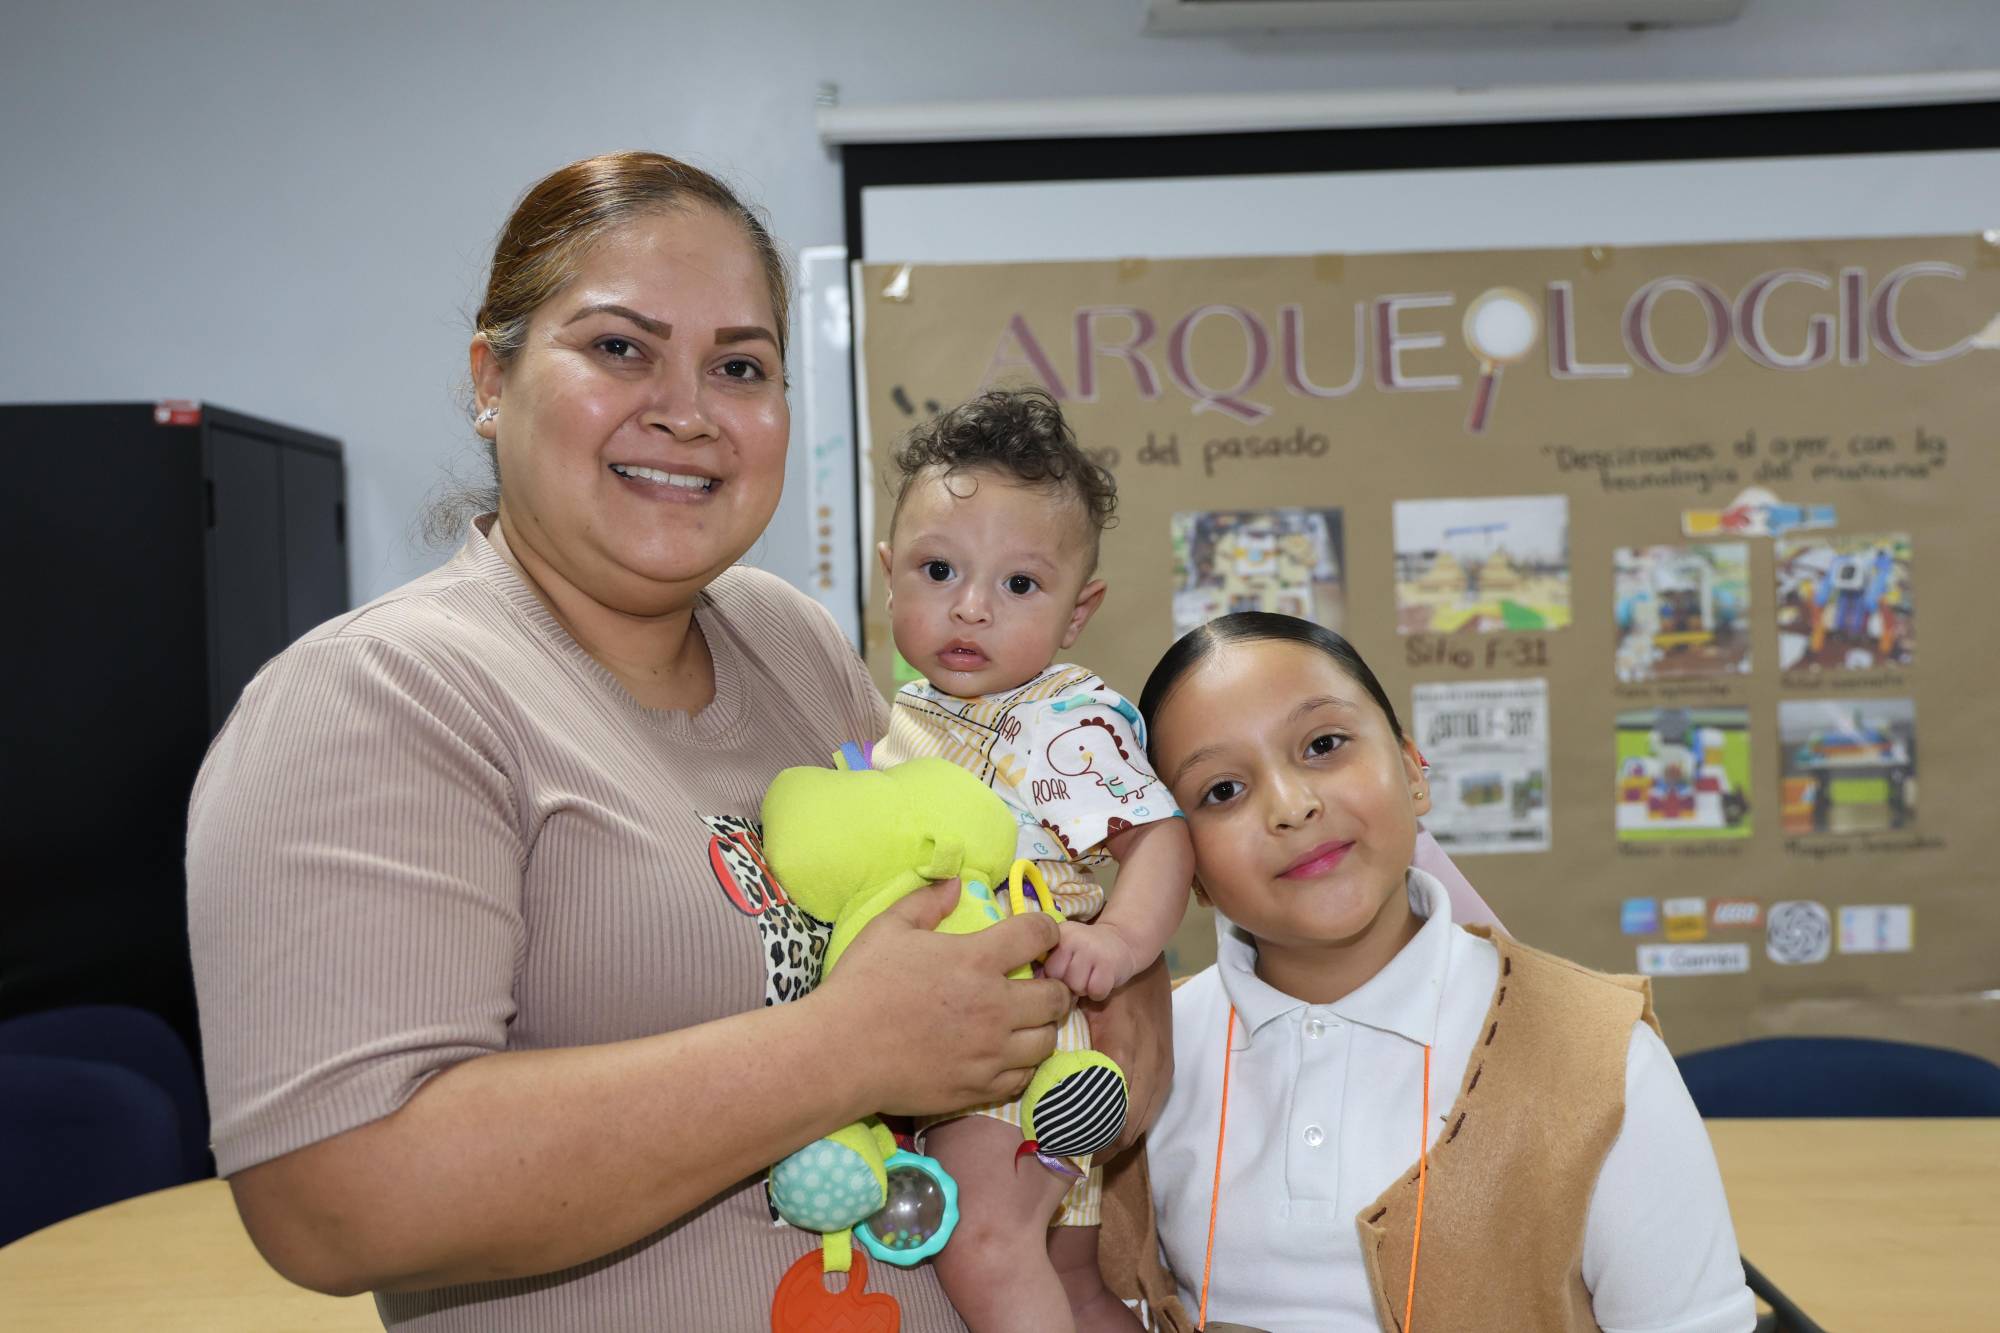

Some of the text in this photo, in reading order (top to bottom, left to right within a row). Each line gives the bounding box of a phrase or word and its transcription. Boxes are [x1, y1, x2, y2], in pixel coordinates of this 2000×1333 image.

[1137, 432, 1182, 466] del
[1203, 427, 1330, 477] pasado
[1032, 778, 1071, 806] ROAR
